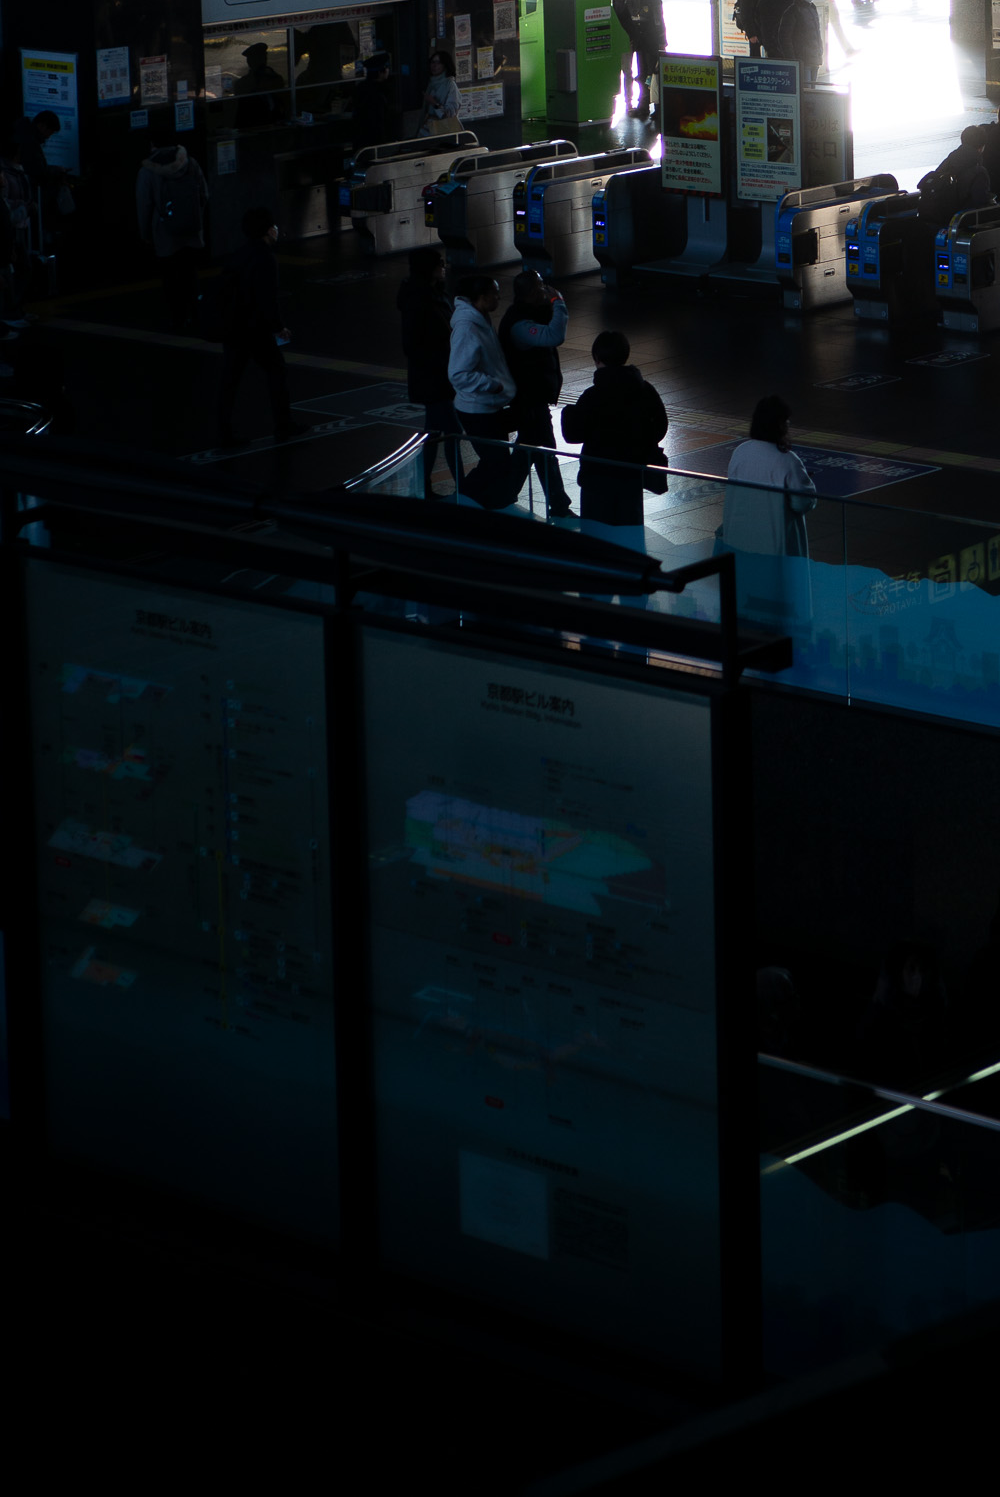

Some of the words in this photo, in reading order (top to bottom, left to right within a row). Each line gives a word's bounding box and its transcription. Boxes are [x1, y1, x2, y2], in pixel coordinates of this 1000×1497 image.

[487, 683, 574, 716] 京都駅ビル案内
